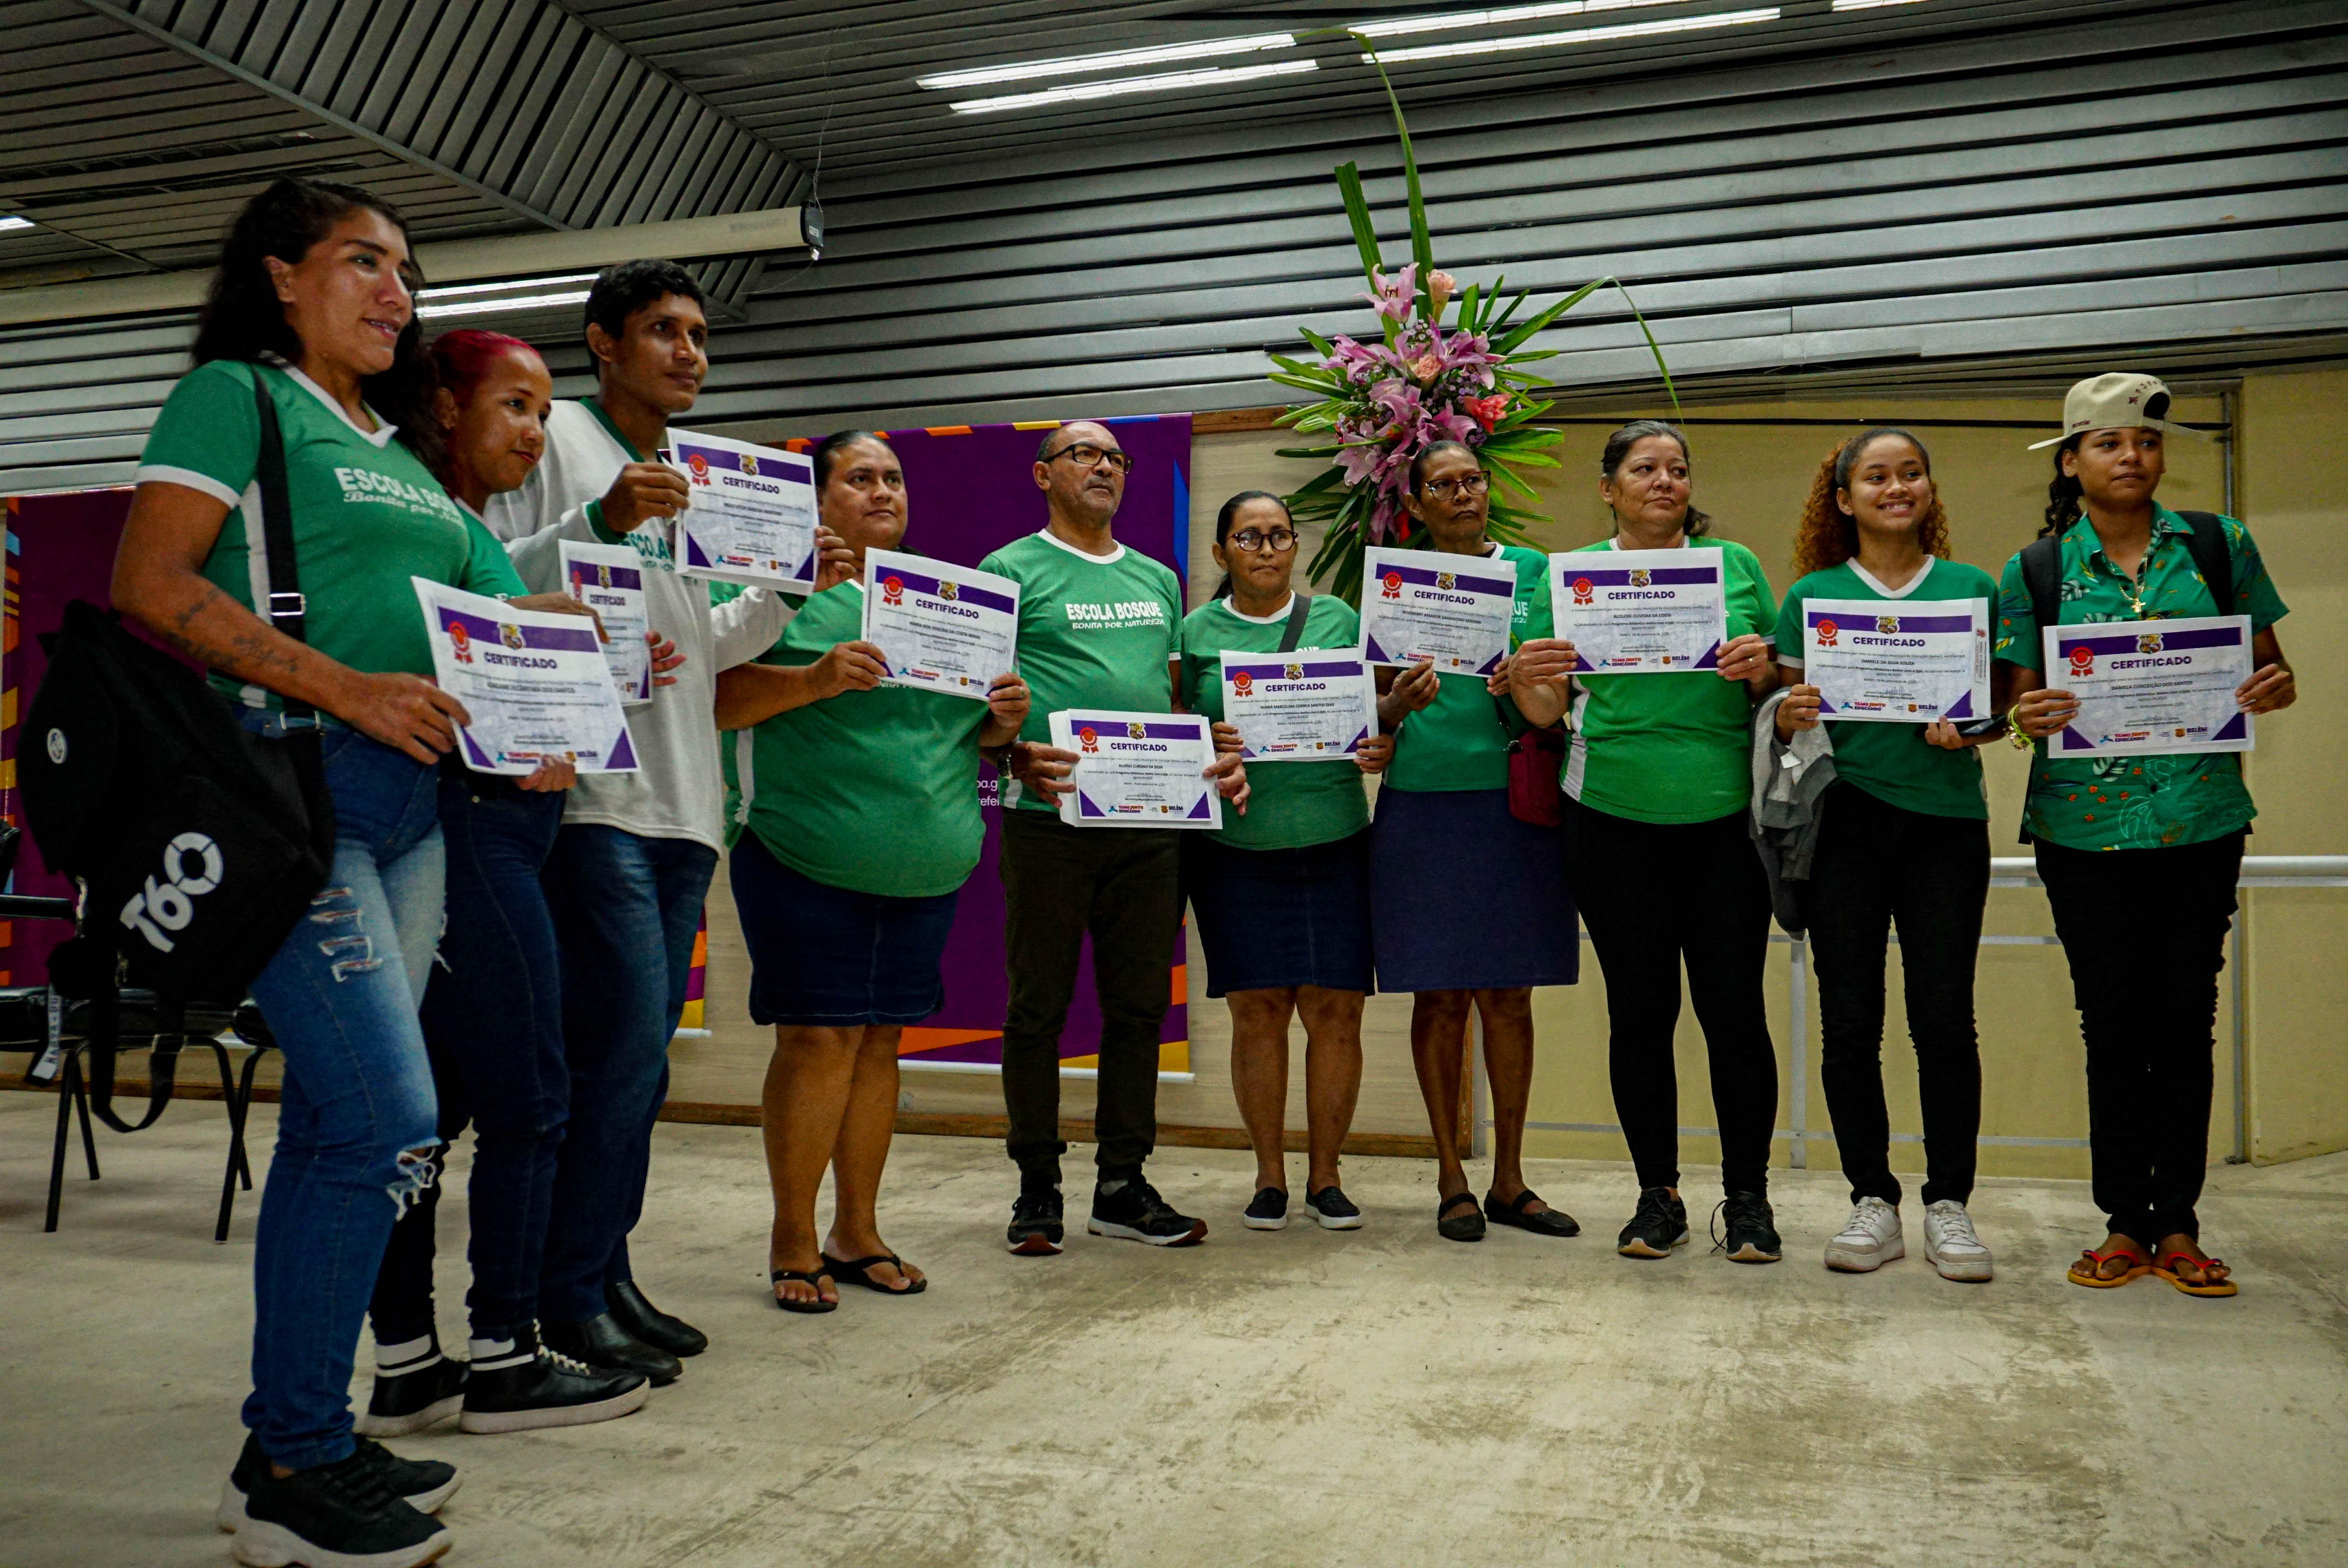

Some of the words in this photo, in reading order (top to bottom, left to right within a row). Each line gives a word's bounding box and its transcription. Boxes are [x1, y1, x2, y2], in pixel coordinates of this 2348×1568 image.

[334, 468, 425, 504] ESCOLA
[723, 476, 779, 494] CERTIFICADO
[589, 594, 626, 606] CERTIFICADO
[1414, 590, 1475, 605] CERTIFICADO
[1608, 591, 1675, 600] CERTIFICADO
[915, 597, 979, 620] CERTIFICADO
[1065, 604, 1115, 621] ESCOLA
[1114, 601, 1163, 620] BOSQUE
[1125, 618, 1165, 627] NATUREZA
[1853, 636, 1925, 647] CERTIFICADO
[482, 650, 559, 671] CERTIFICADO
[2111, 656, 2192, 669] CERTIFICADO
[1265, 683, 1326, 692] CERTIFICADO
[1110, 742, 1167, 751] CERTIFICADO
